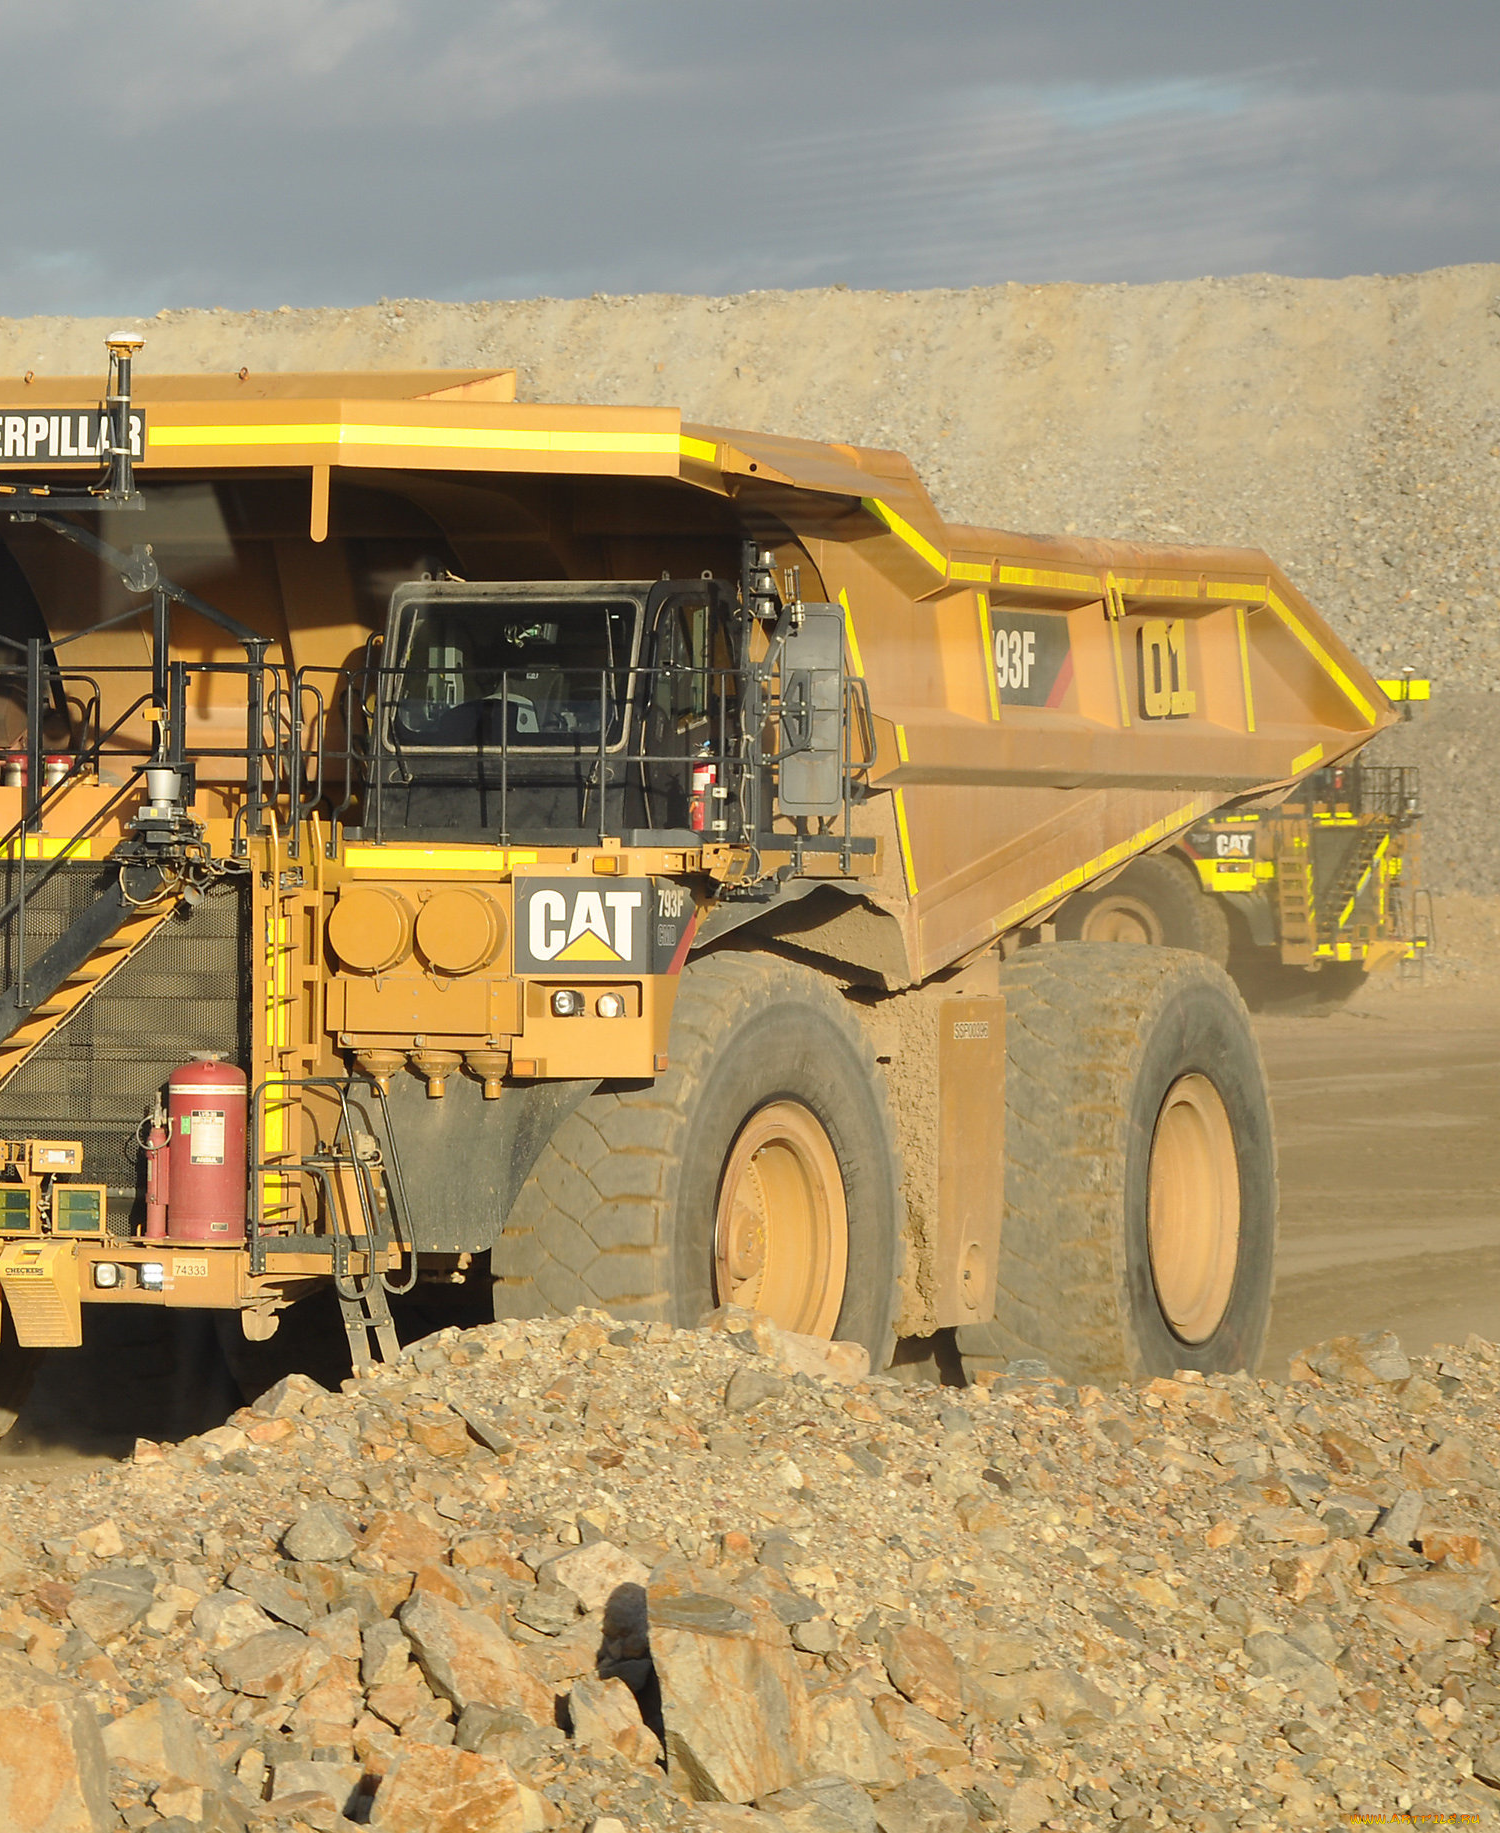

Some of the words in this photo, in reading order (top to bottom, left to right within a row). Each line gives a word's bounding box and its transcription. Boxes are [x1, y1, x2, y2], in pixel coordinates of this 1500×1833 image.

[992, 629, 1035, 689] 93F
[1141, 619, 1197, 718] 01
[1216, 834, 1252, 856] CAT
[529, 889, 642, 961] CAT
[658, 889, 684, 918] 793F
[175, 1265, 206, 1276] 74333
